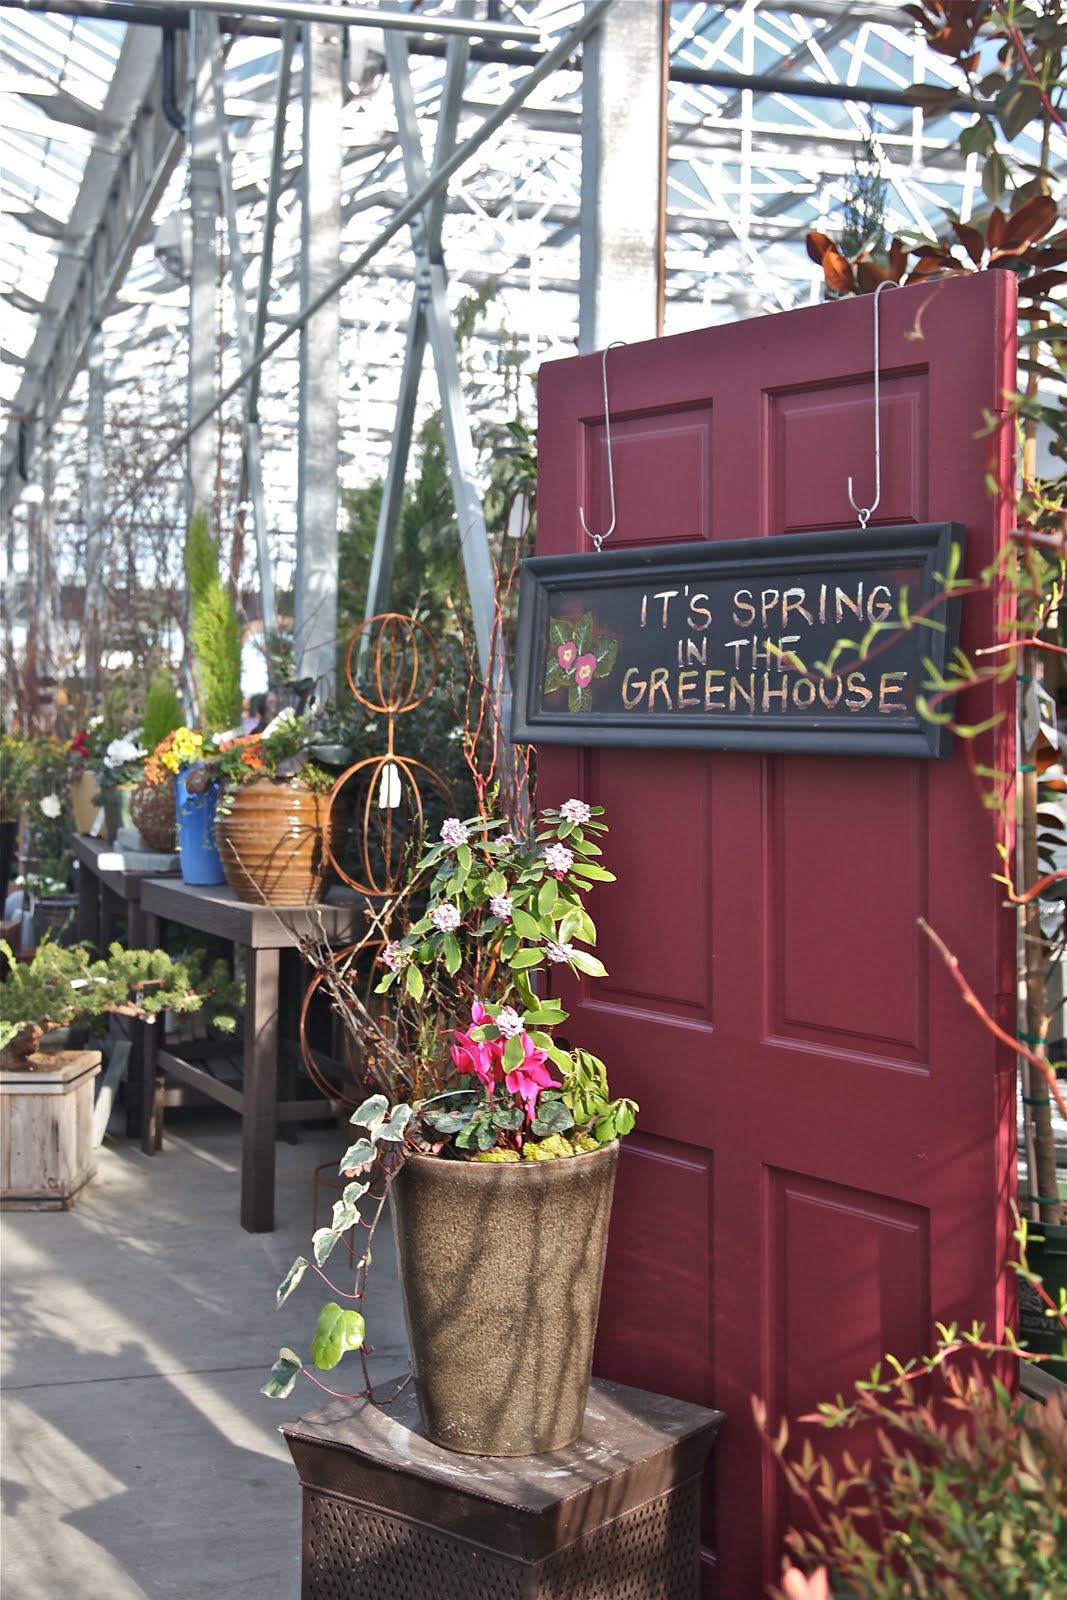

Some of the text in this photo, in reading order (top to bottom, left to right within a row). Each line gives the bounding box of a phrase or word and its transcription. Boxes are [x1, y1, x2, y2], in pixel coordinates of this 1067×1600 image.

[640, 582, 892, 631] IT'S SPRING
[678, 634, 801, 672] IN THE
[622, 667, 907, 713] GREENHOUSE
